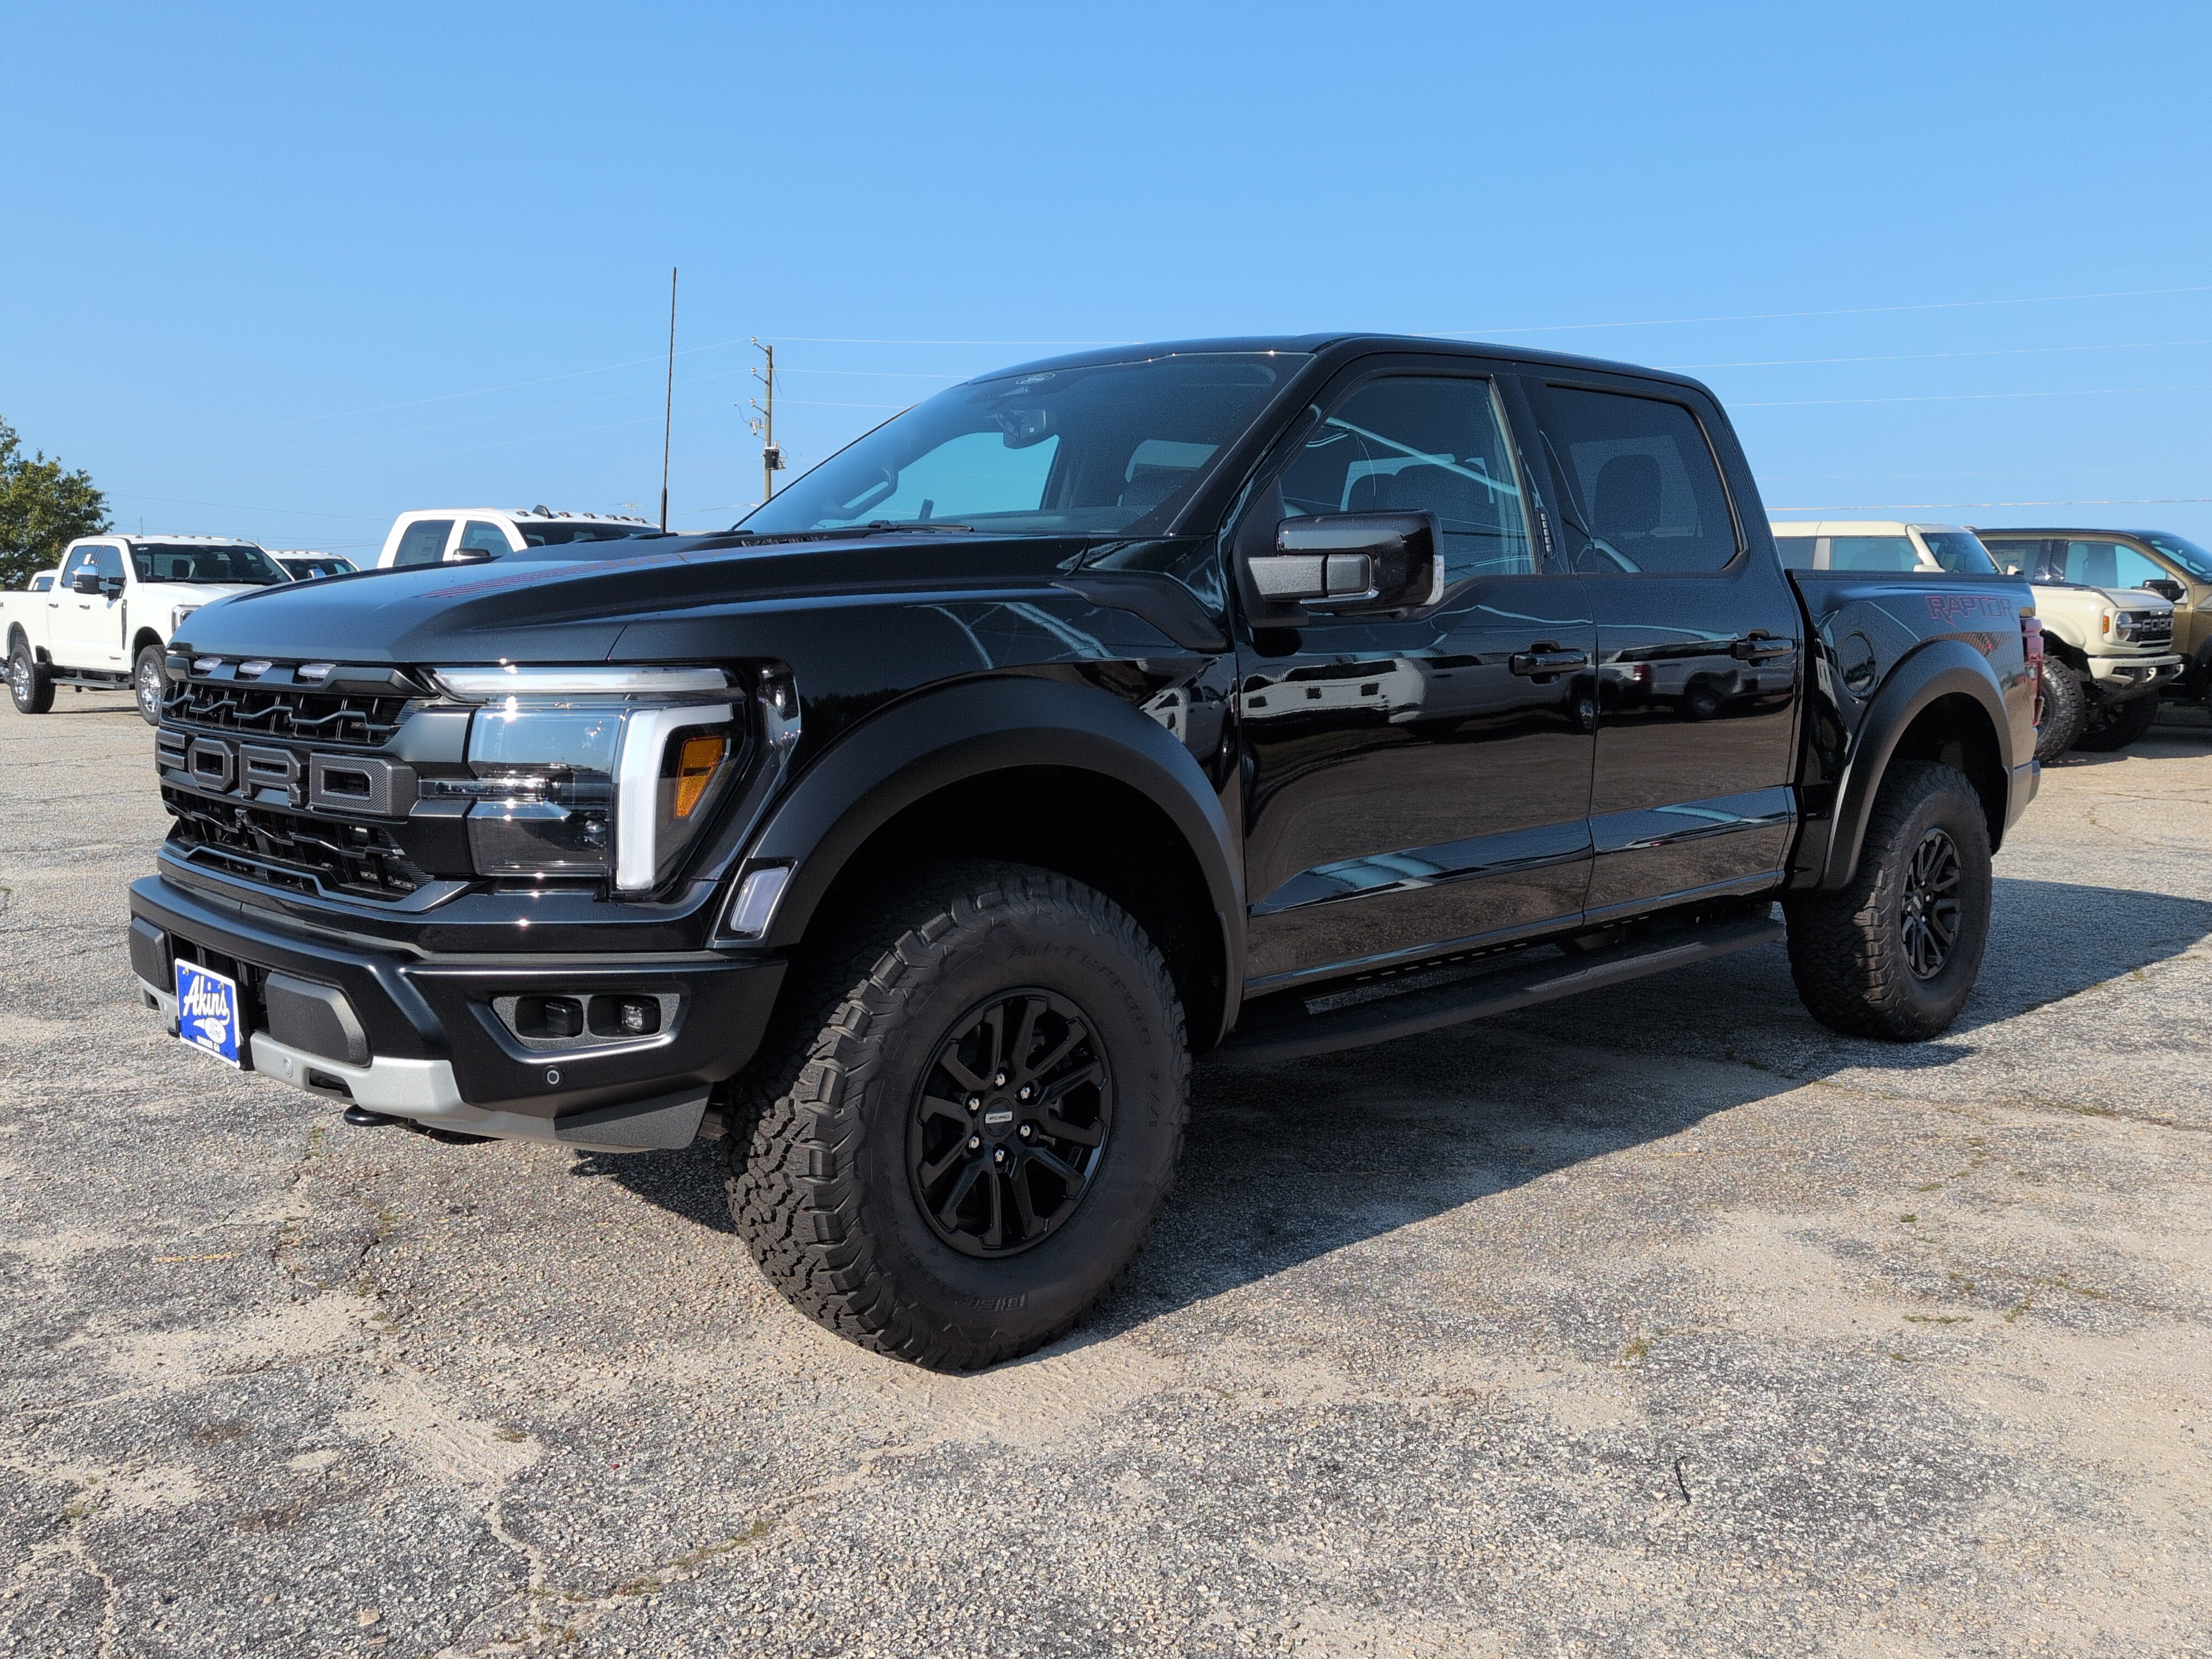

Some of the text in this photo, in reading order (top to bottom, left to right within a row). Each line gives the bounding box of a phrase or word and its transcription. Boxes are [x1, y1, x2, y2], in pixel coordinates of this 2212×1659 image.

[1925, 595, 2016, 628] RAPTOR
[2142, 618, 2172, 632] FORD
[155, 728, 393, 817] FORD
[183, 975, 229, 1017] Akins
